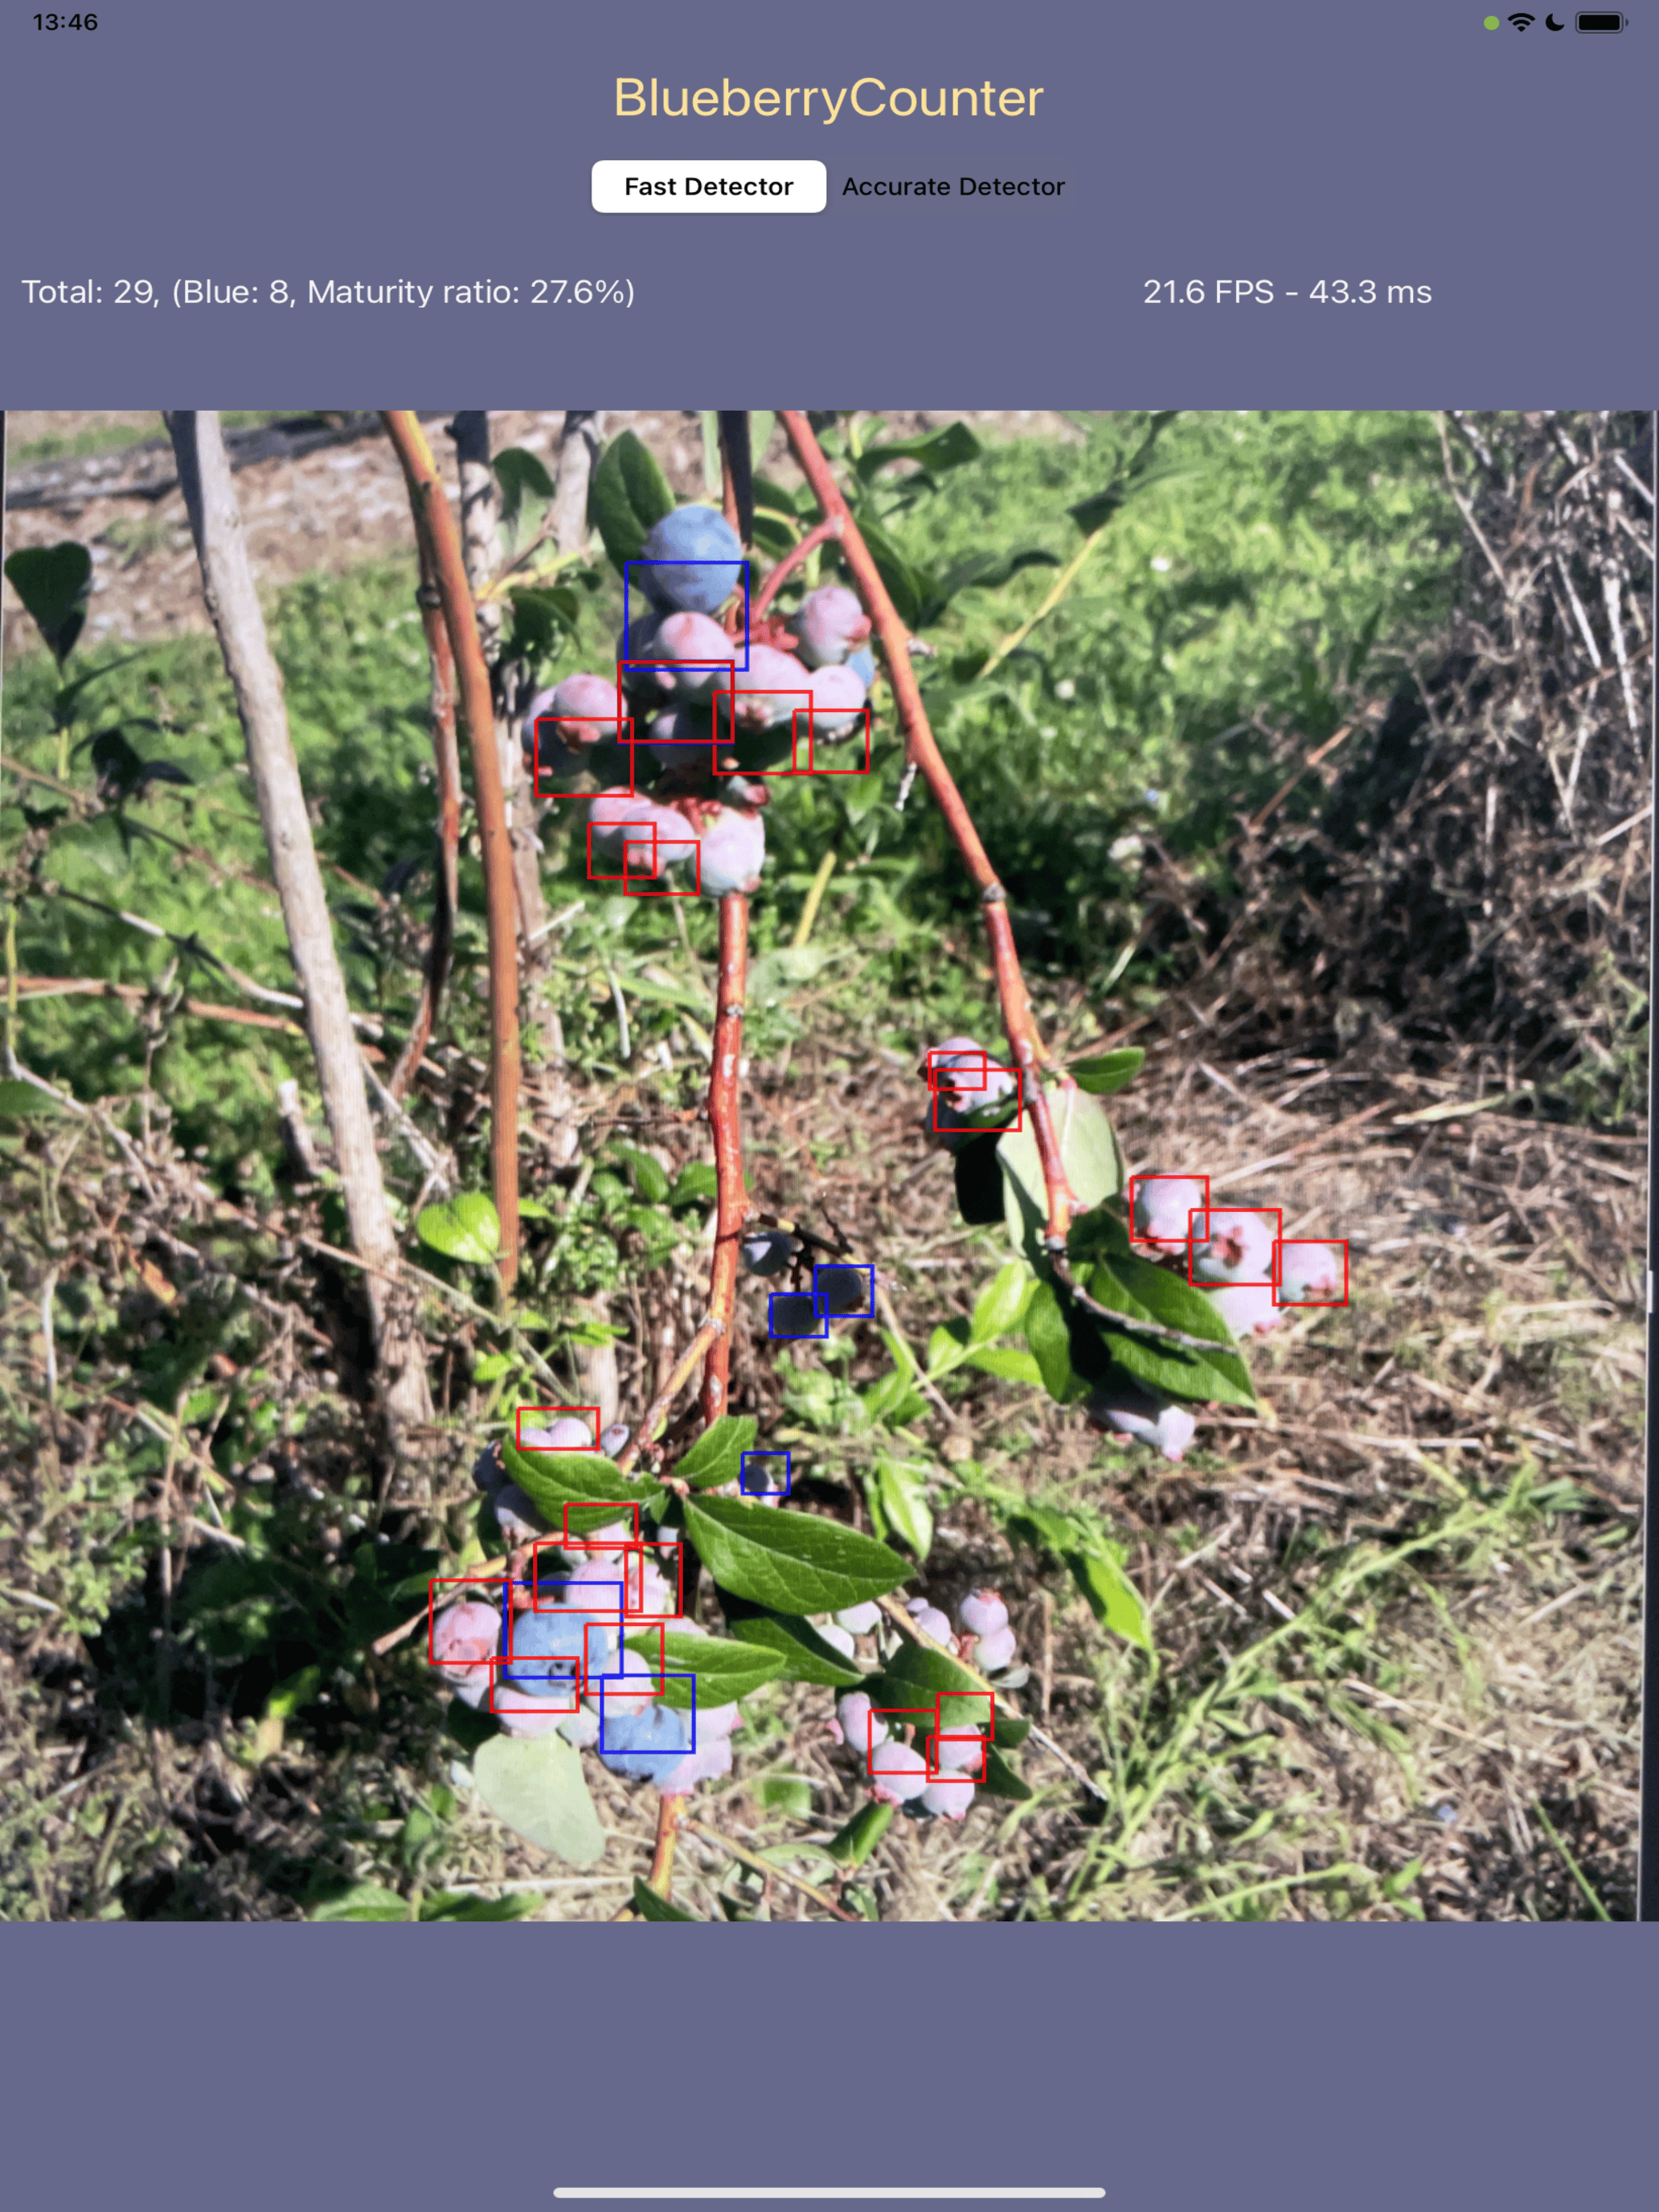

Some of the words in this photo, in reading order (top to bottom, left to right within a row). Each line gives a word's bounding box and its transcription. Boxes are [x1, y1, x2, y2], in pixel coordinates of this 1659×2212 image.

[33, 13, 98, 31] 13:46
[616, 77, 1045, 125] BlueberryCounter
[625, 177, 678, 196] Fast
[685, 177, 795, 196] Detector
[842, 177, 951, 196] Accurate
[960, 177, 1066, 196] Detector
[21, 278, 102, 304] Total:
[114, 279, 159, 309] 29,
[173, 278, 258, 309] (Blue:
[269, 279, 296, 309] 8,
[309, 278, 434, 309] Maturity
[444, 278, 519, 304] ratio:
[530, 278, 634, 309] 27.6%)
[1144, 279, 1206, 305] 21.6
[1216, 279, 1274, 305] FPS
[1309, 279, 1377, 304] 43.3
[1387, 285, 1432, 304] ms
